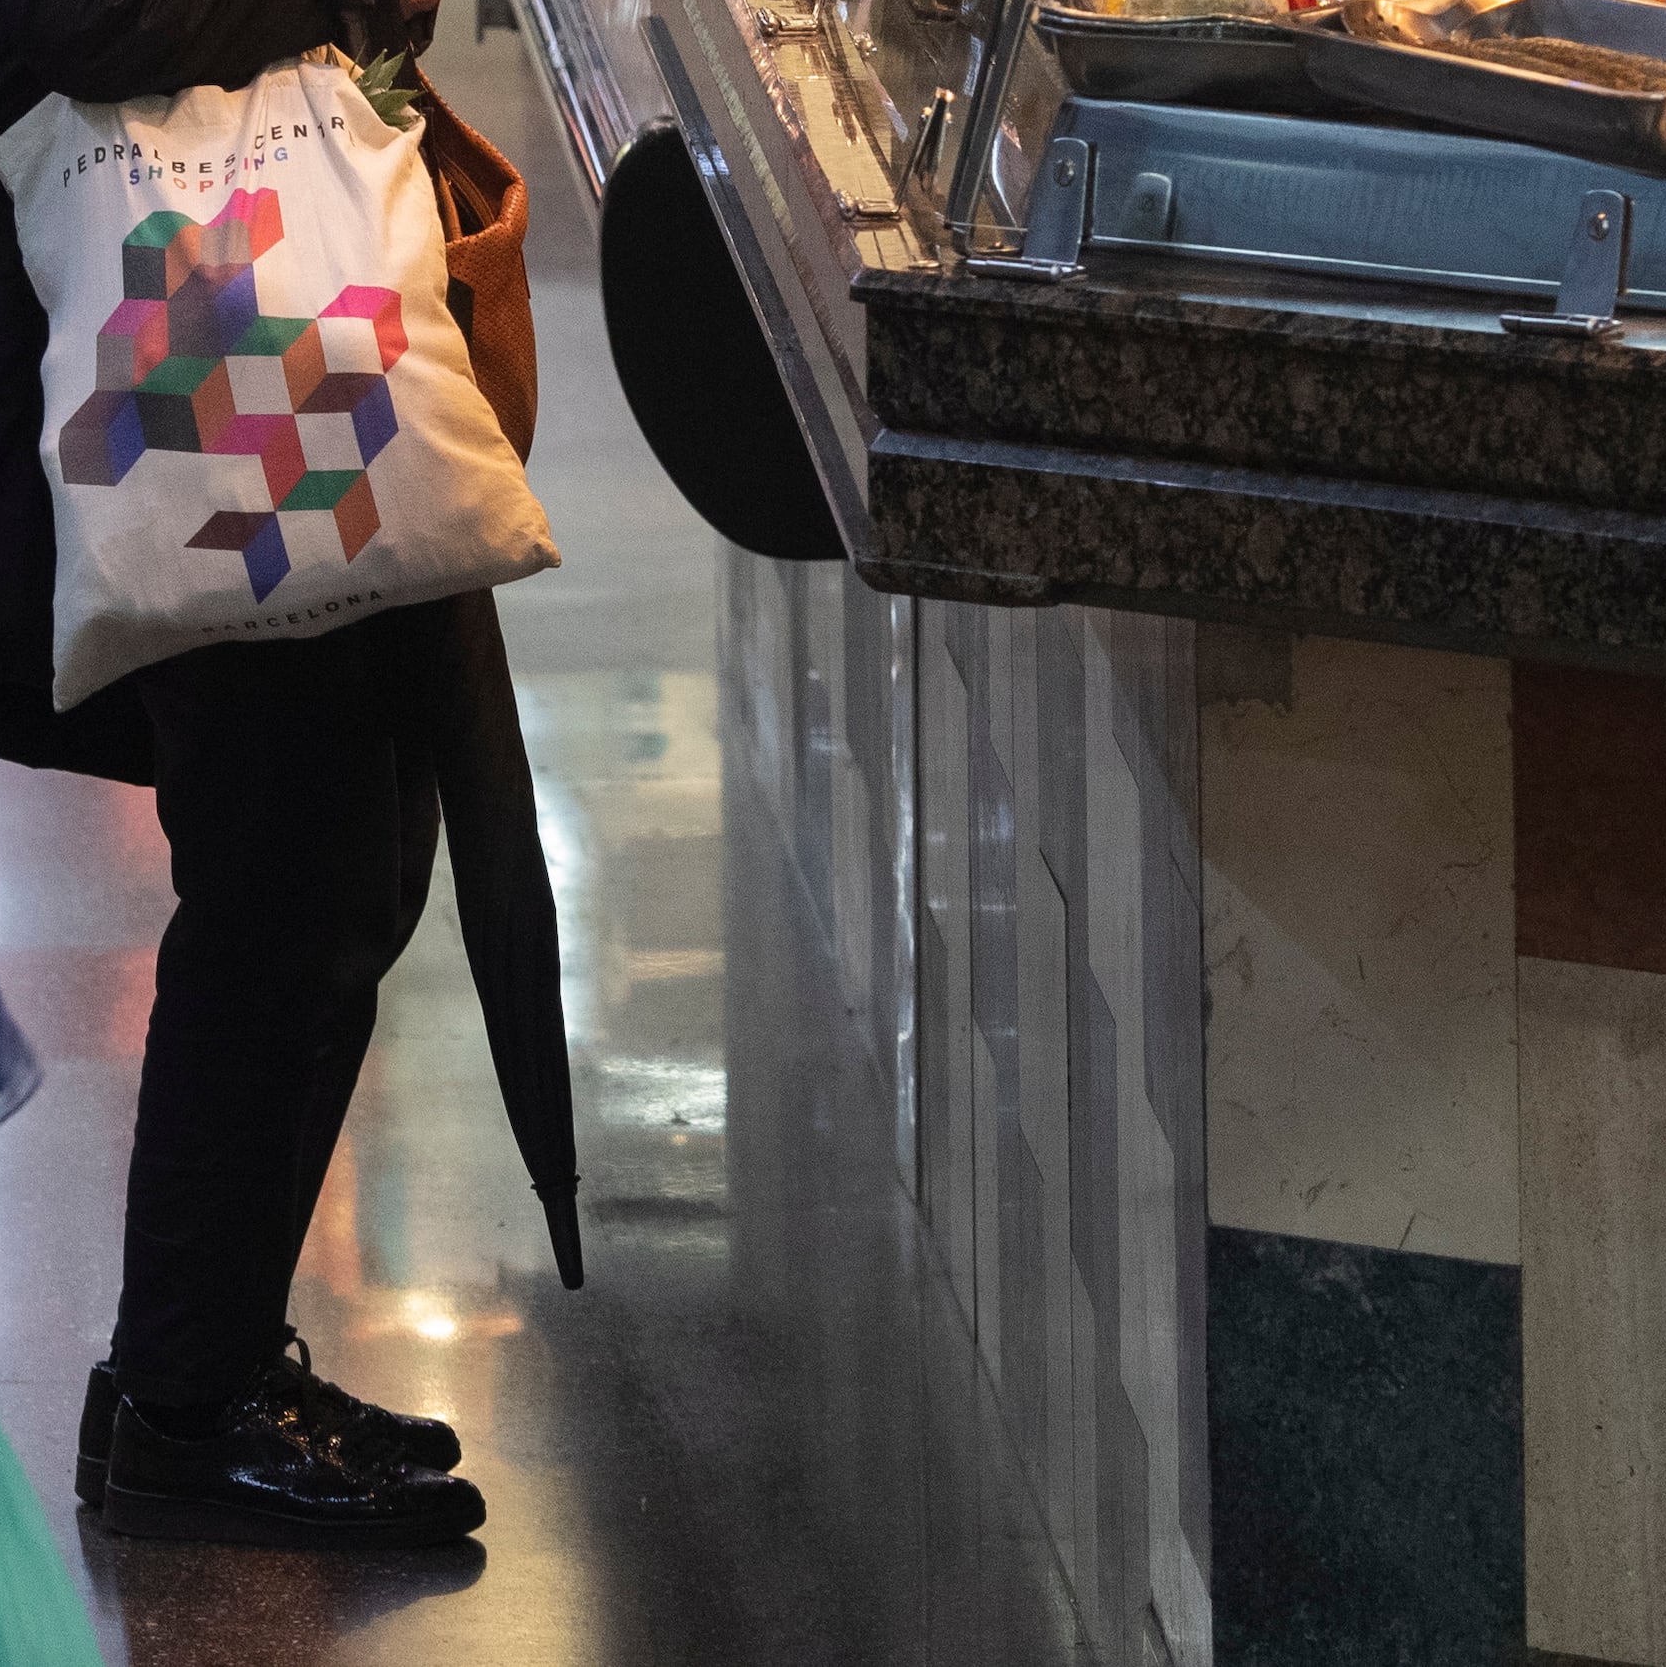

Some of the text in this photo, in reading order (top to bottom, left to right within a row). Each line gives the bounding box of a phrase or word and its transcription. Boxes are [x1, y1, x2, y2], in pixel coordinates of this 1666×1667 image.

[61, 115, 357, 188] PEDRALBES CENTR
[129, 147, 290, 194] SHOPPING
